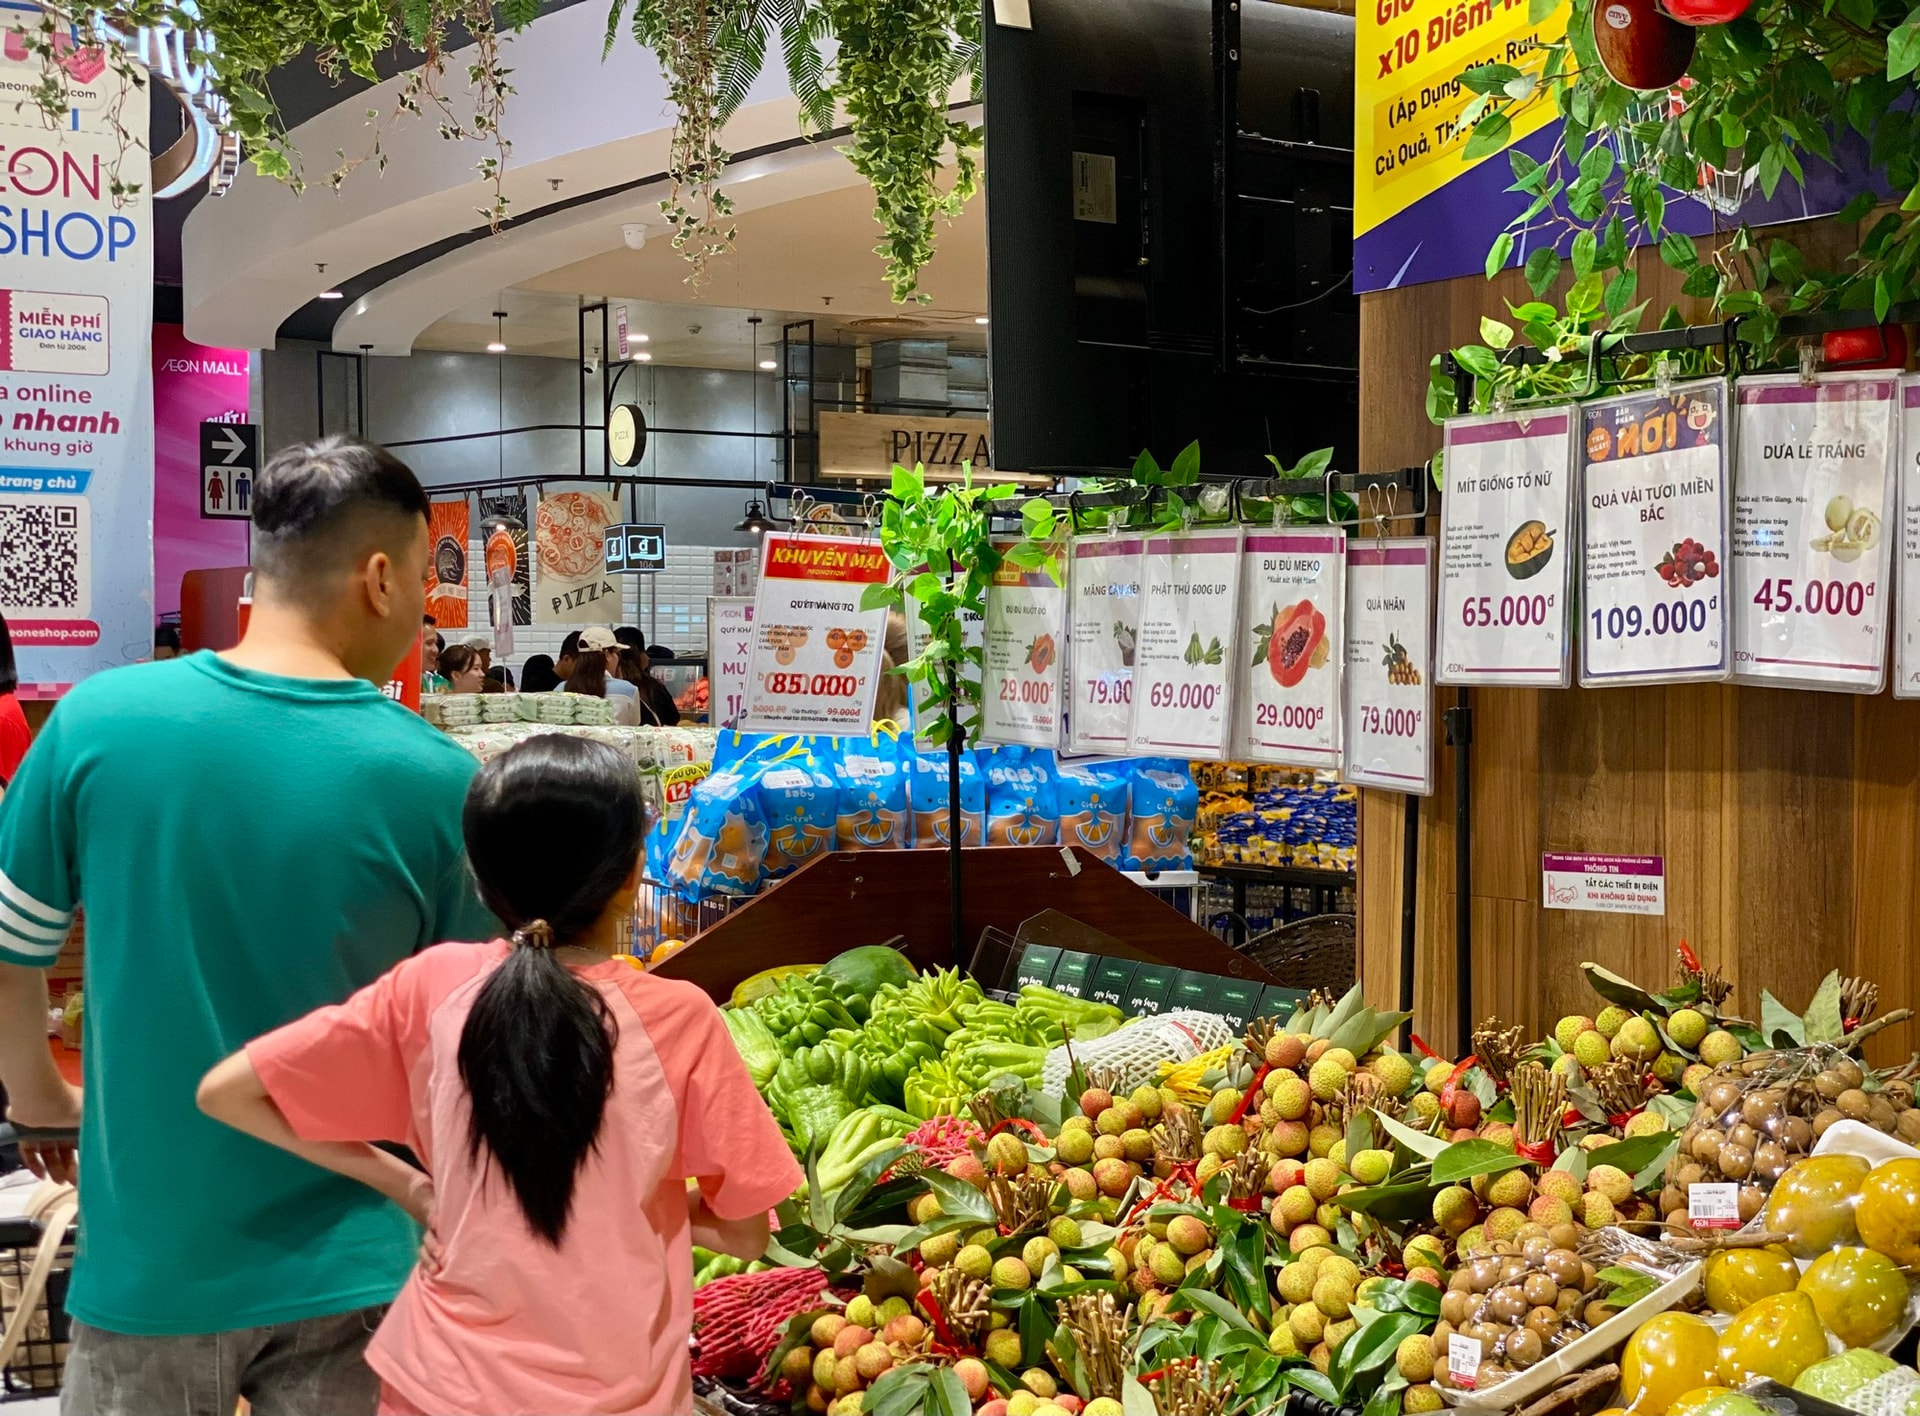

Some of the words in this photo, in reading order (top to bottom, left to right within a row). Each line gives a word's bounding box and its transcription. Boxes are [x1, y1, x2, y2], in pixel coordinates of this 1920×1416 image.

[1377, 28, 1419, 80] x10
[1388, 99, 1417, 128] (Áp
[1421, 77, 1461, 110] Dụng
[1375, 149, 1395, 177] Củ
[1399, 132, 1431, 166] Quả,
[19, 307, 65, 328] MIỄN
[71, 313, 101, 329] PHÍ
[19, 328, 56, 339] GIAO
[61, 328, 103, 343] HÀNG
[67, 343, 87, 351] 200K
[203, 360, 242, 377] MALL
[16, 383, 92, 405] online
[12, 407, 120, 435] nhanh
[4, 438, 61, 456] khung
[66, 440, 94, 457] giờ
[891, 429, 991, 467] PIZZA
[1763, 443, 1794, 460] DƯA
[1798, 441, 1813, 459] LÊ
[1816, 439, 1865, 459] TRẮNG
[0, 475, 43, 490] trang
[46, 474, 77, 489] chủ
[1457, 475, 1477, 493] MÍT
[1479, 474, 1514, 492] GIỐNG
[1517, 471, 1532, 489] TỐ
[1534, 470, 1552, 487] NỮ
[1591, 488, 1618, 509] QUẢ
[1621, 485, 1642, 504] VẢI
[1645, 482, 1677, 502] TƯƠI
[1680, 476, 1714, 497] MIỀN
[1640, 502, 1665, 522] BẮC
[772, 545, 848, 567] KHUYẾN
[850, 552, 884, 573] MẠI
[1263, 559, 1277, 571] ĐU
[1279, 556, 1292, 571] ĐỦ
[1294, 559, 1320, 572] MEKO
[552, 580, 615, 615] PIZZA
[1084, 584, 1106, 596] MÃNG
[1151, 583, 1172, 598] PHẬT
[1174, 581, 1190, 595] THỦ
[1192, 584, 1213, 595] 600G
[1215, 585, 1227, 595] UP
[1366, 597, 1381, 611] QUẢ
[1383, 596, 1405, 611] NHÃN
[1584, 863, 1607, 873] THÔNG
[1609, 865, 1619, 873] TIN
[1598, 878, 1614, 888] CÁC
[1615, 879, 1632, 890] THIẾT
[1634, 882, 1641, 891] BỊ
[1642, 881, 1658, 892] ĐIỆN
[1587, 892, 1599, 900] KHI
[1600, 891, 1625, 901] KHÔNG
[1637, 894, 1657, 904] DỤNG
